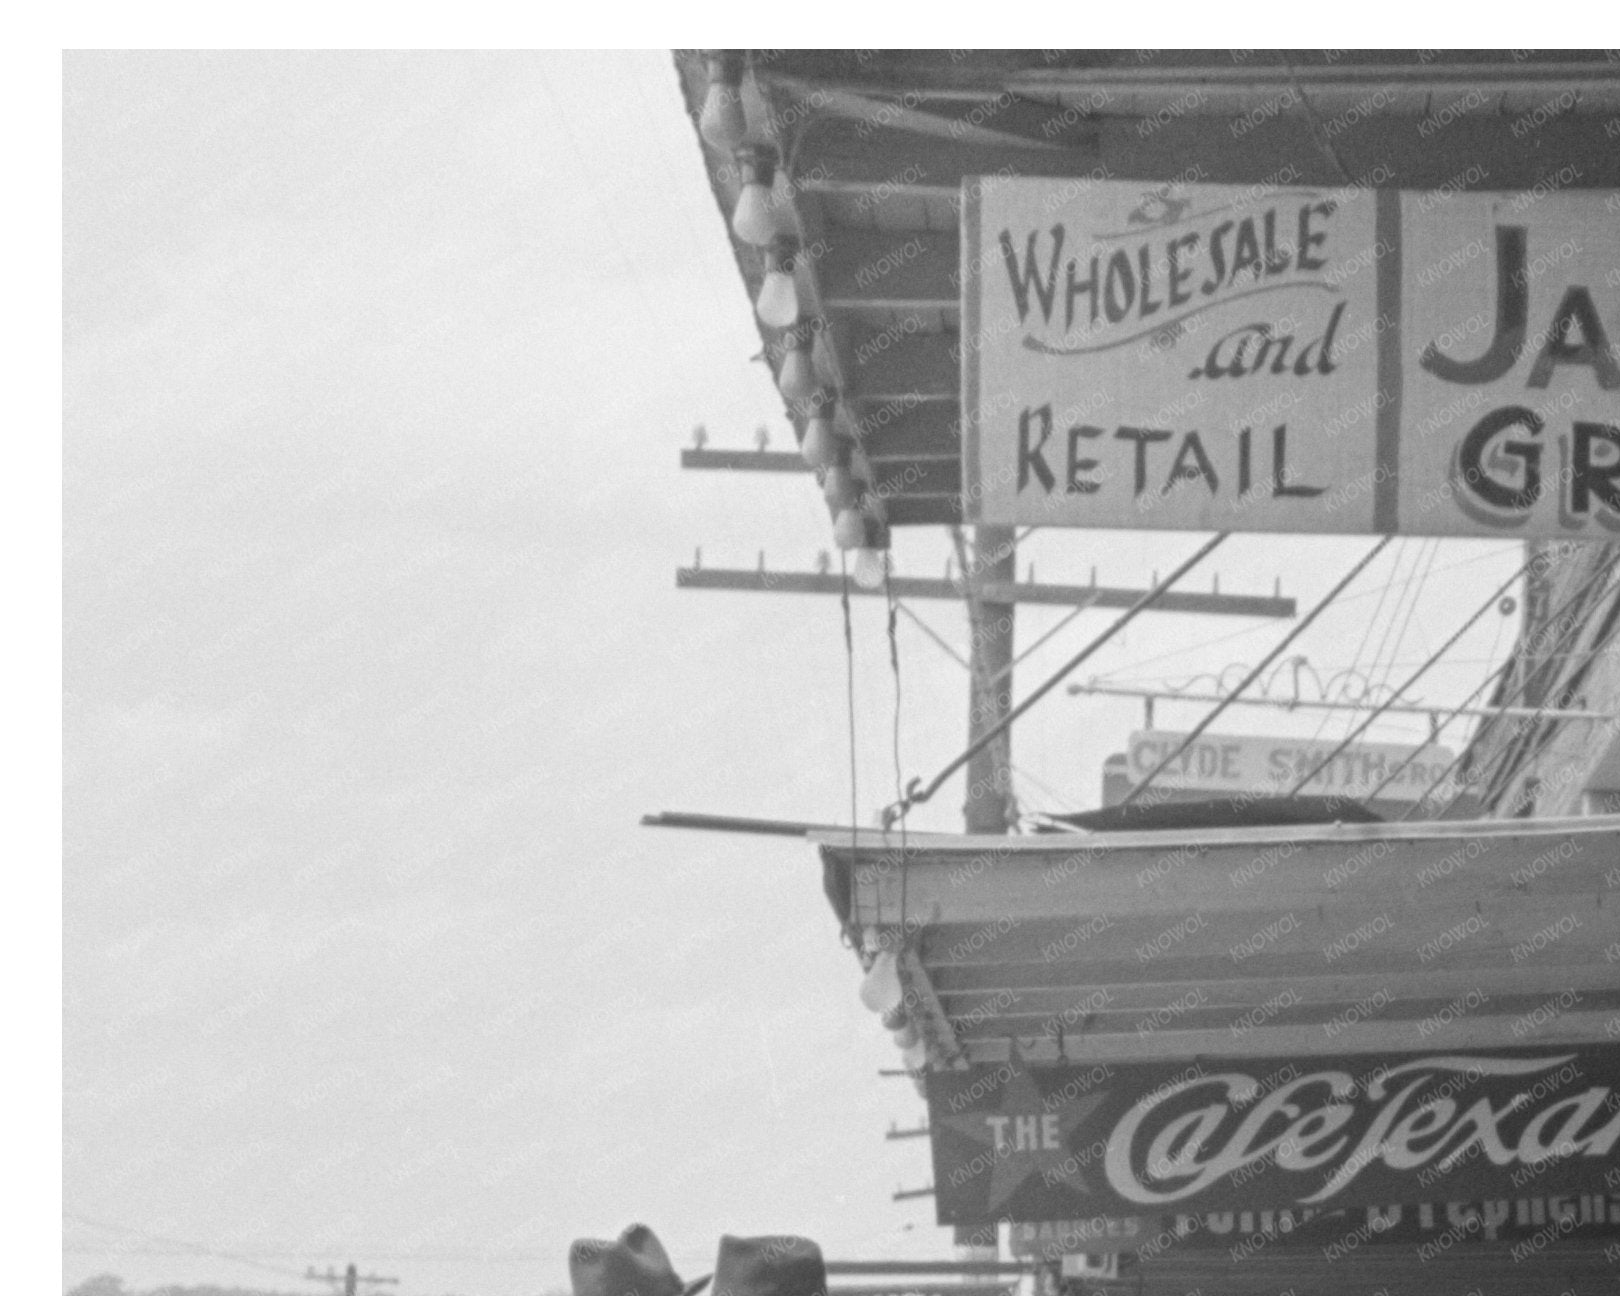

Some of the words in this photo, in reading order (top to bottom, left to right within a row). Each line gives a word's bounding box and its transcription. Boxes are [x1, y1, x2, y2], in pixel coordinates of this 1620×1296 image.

[1000, 200, 1339, 332] WHOLESALE
[1188, 301, 1348, 380] and
[1015, 403, 1331, 498] RETAIL
[985, 1114, 1061, 1151] THE
[1104, 1071, 1354, 1203] Cafe
